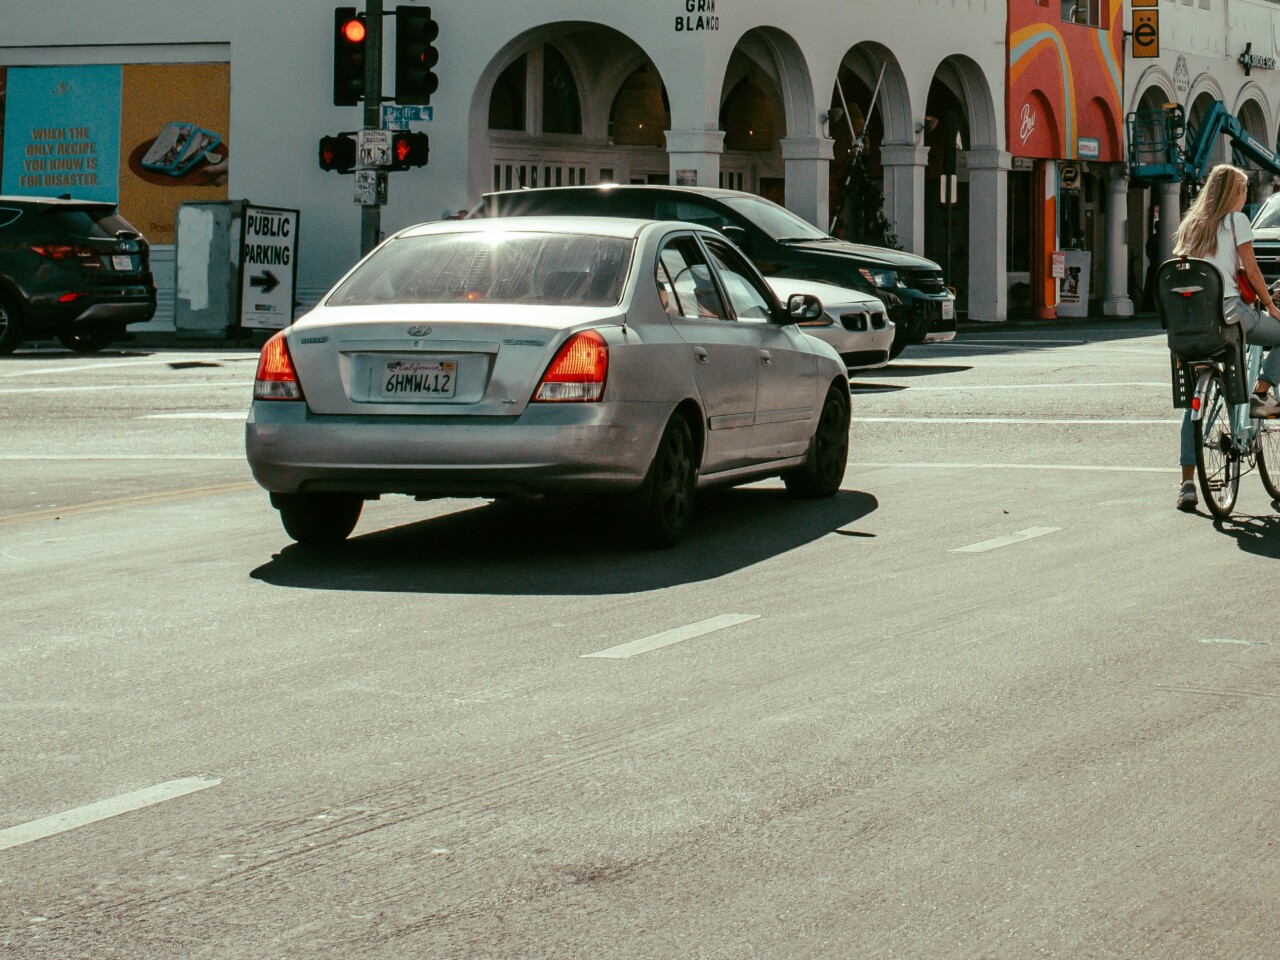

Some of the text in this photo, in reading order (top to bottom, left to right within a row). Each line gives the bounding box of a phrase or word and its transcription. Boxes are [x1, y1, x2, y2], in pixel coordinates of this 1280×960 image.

[674, 16, 720, 32] BLANCO
[387, 107, 415, 119] Pacific
[32, 127, 89, 141] WHEN THE
[26, 142, 96, 156] ONLY RECIPE
[360, 148, 373, 161] OK
[24, 157, 97, 171] YOU KNOW IS
[20, 173, 100, 187] FOR DISASTER.
[247, 215, 291, 237] PUBLIC
[244, 243, 291, 266] PARKING
[399, 361, 443, 373] California
[386, 374, 451, 393] 6HMW412
